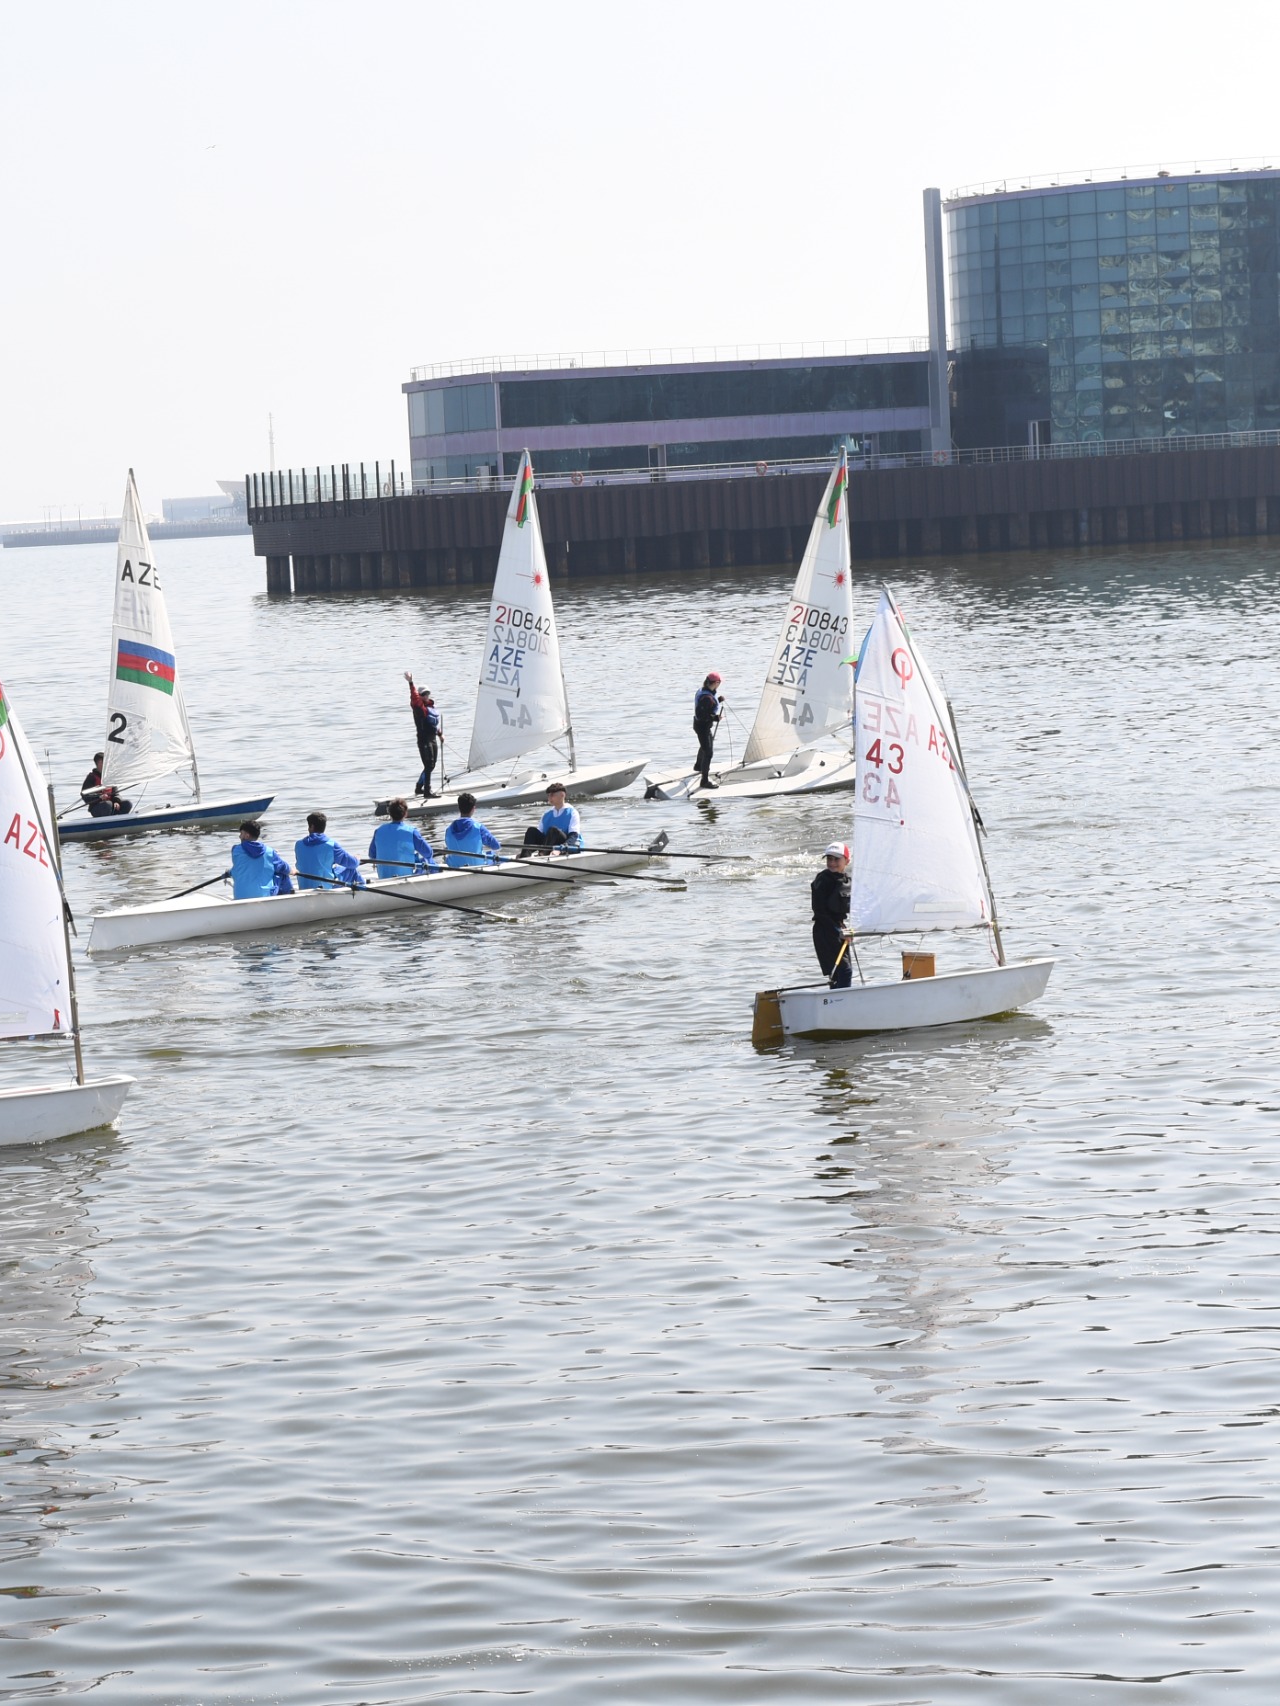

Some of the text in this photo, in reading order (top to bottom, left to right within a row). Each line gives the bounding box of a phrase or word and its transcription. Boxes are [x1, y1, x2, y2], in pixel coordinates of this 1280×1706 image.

[121, 559, 162, 591] AZE
[495, 605, 551, 636] 210842
[790, 605, 848, 635] 210843
[489, 644, 525, 668] AZE
[779, 644, 817, 668] AZE
[108, 712, 127, 744] 2
[865, 738, 904, 775] 43
[4, 812, 49, 868] AZE
